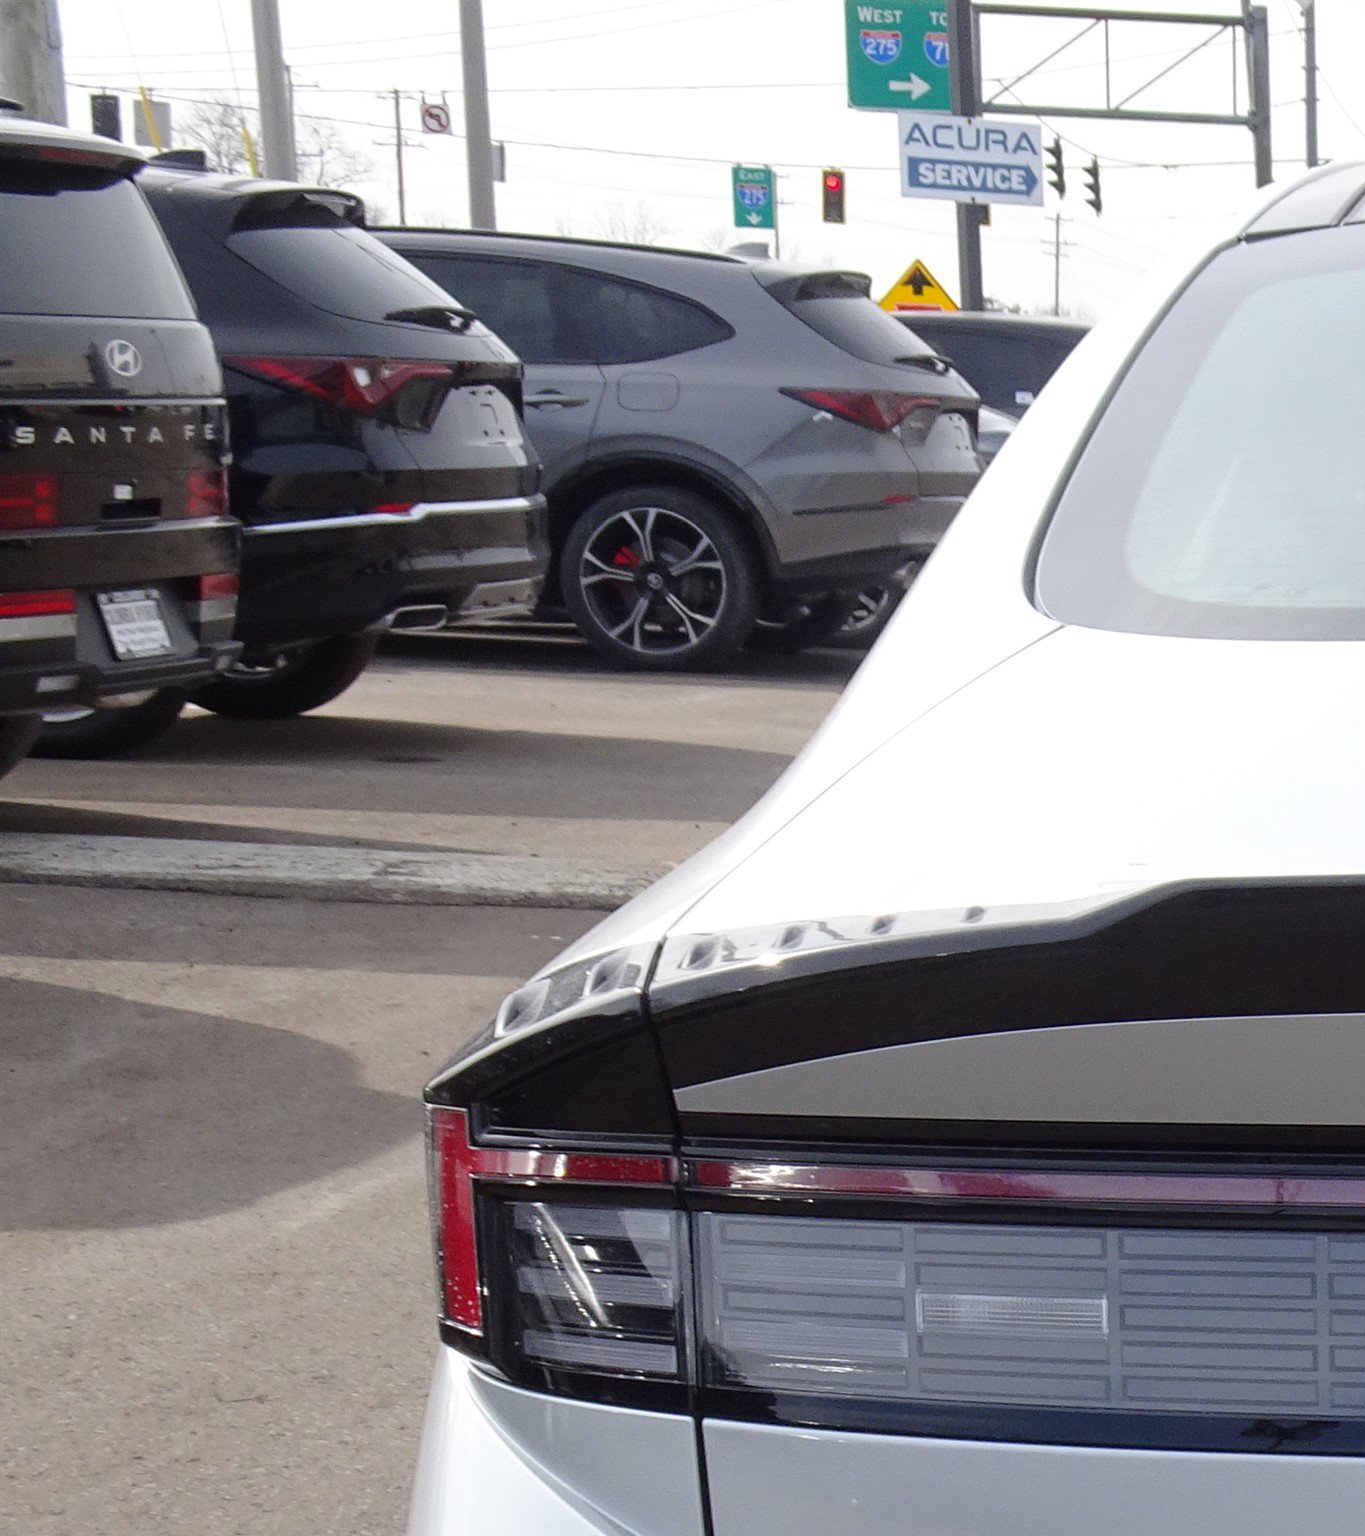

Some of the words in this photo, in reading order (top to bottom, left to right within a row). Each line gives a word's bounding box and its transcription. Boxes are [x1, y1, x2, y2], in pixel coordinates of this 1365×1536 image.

[857, 6, 903, 24] WEST
[865, 38, 898, 56] 275
[904, 122, 1038, 156] ACURA
[918, 161, 1027, 191] SERVICE
[15, 426, 164, 444] SANTA
[183, 423, 215, 441] FE
